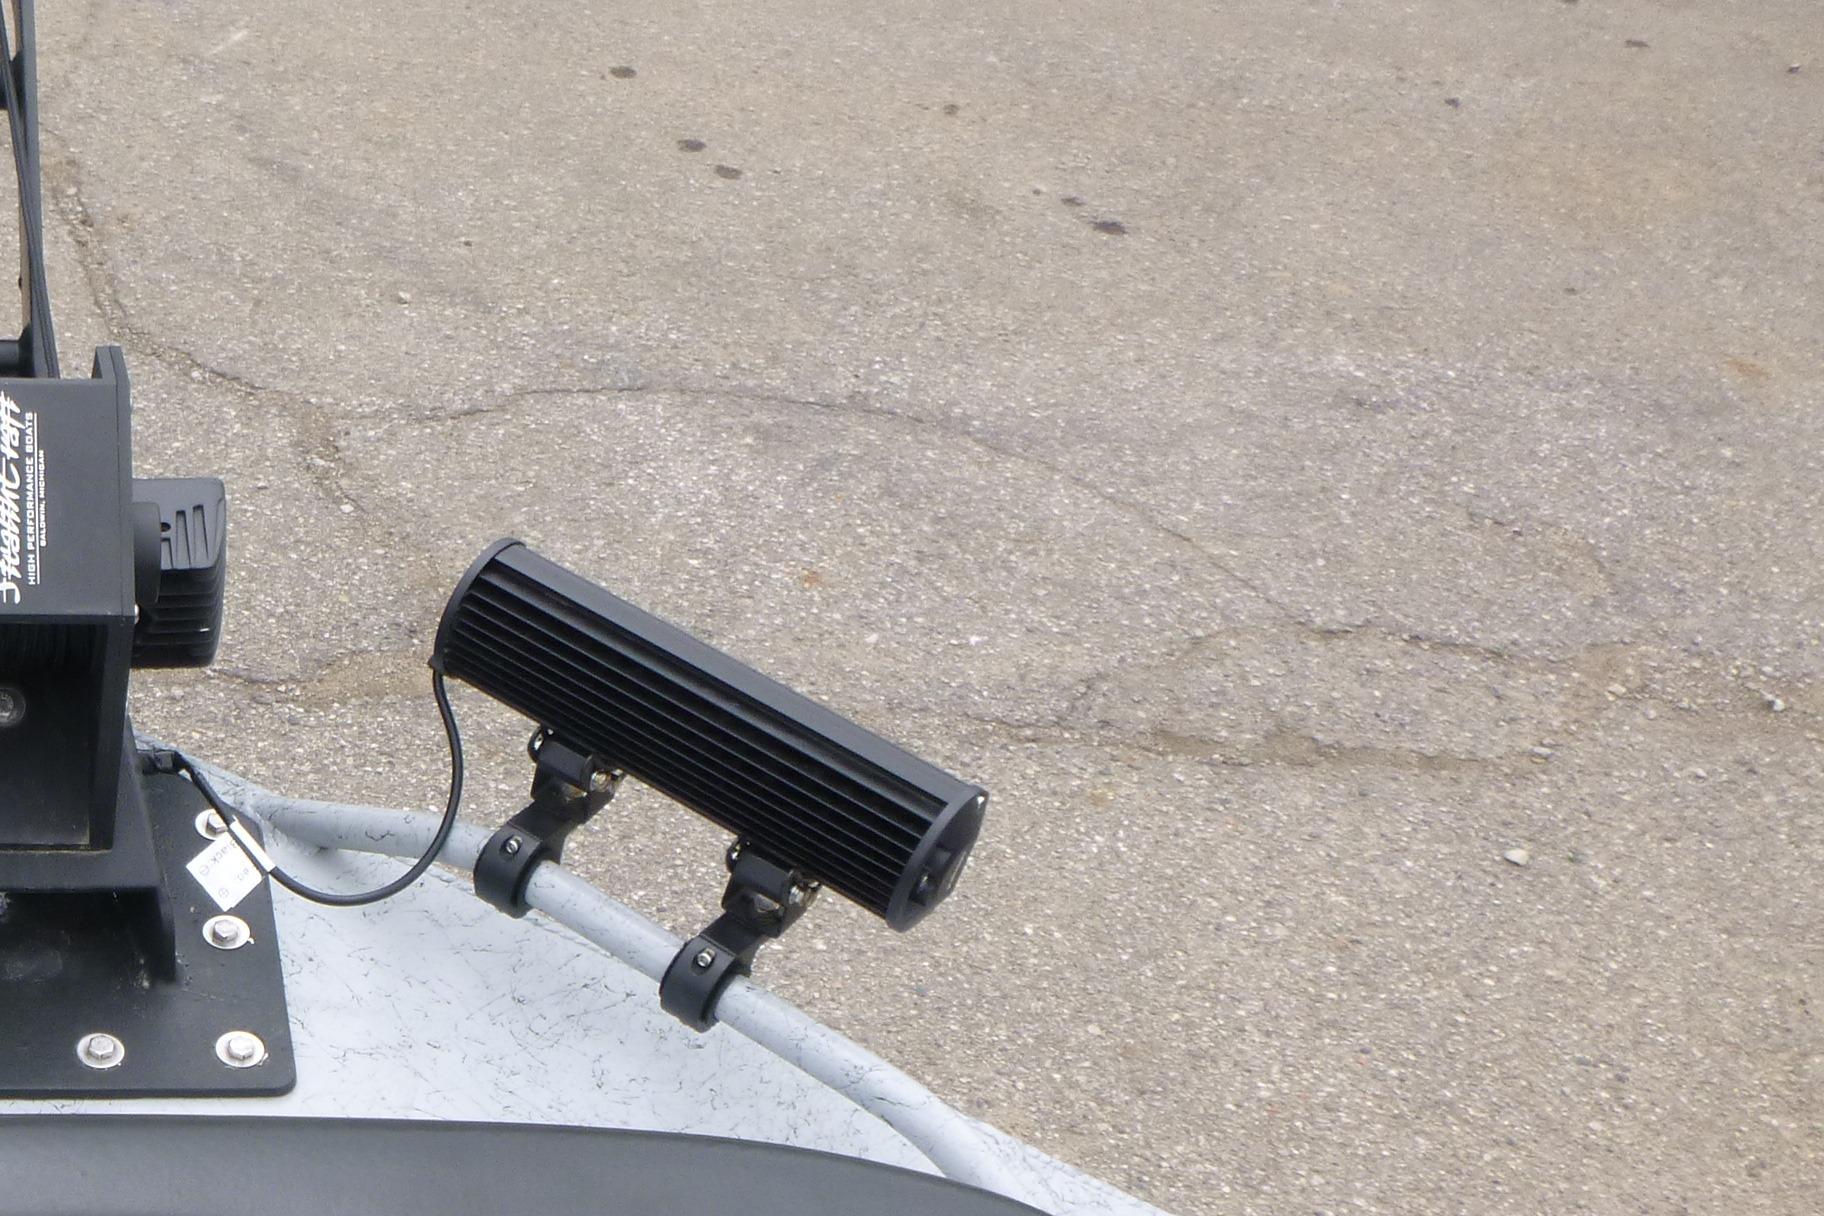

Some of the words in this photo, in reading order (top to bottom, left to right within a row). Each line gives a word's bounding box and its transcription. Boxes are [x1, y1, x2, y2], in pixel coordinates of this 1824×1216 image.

[25, 412, 34, 452] BOATS
[26, 457, 36, 550] PERFORMANCE
[39, 499, 47, 547] BALDWIN,
[27, 554, 36, 585] HIGH
